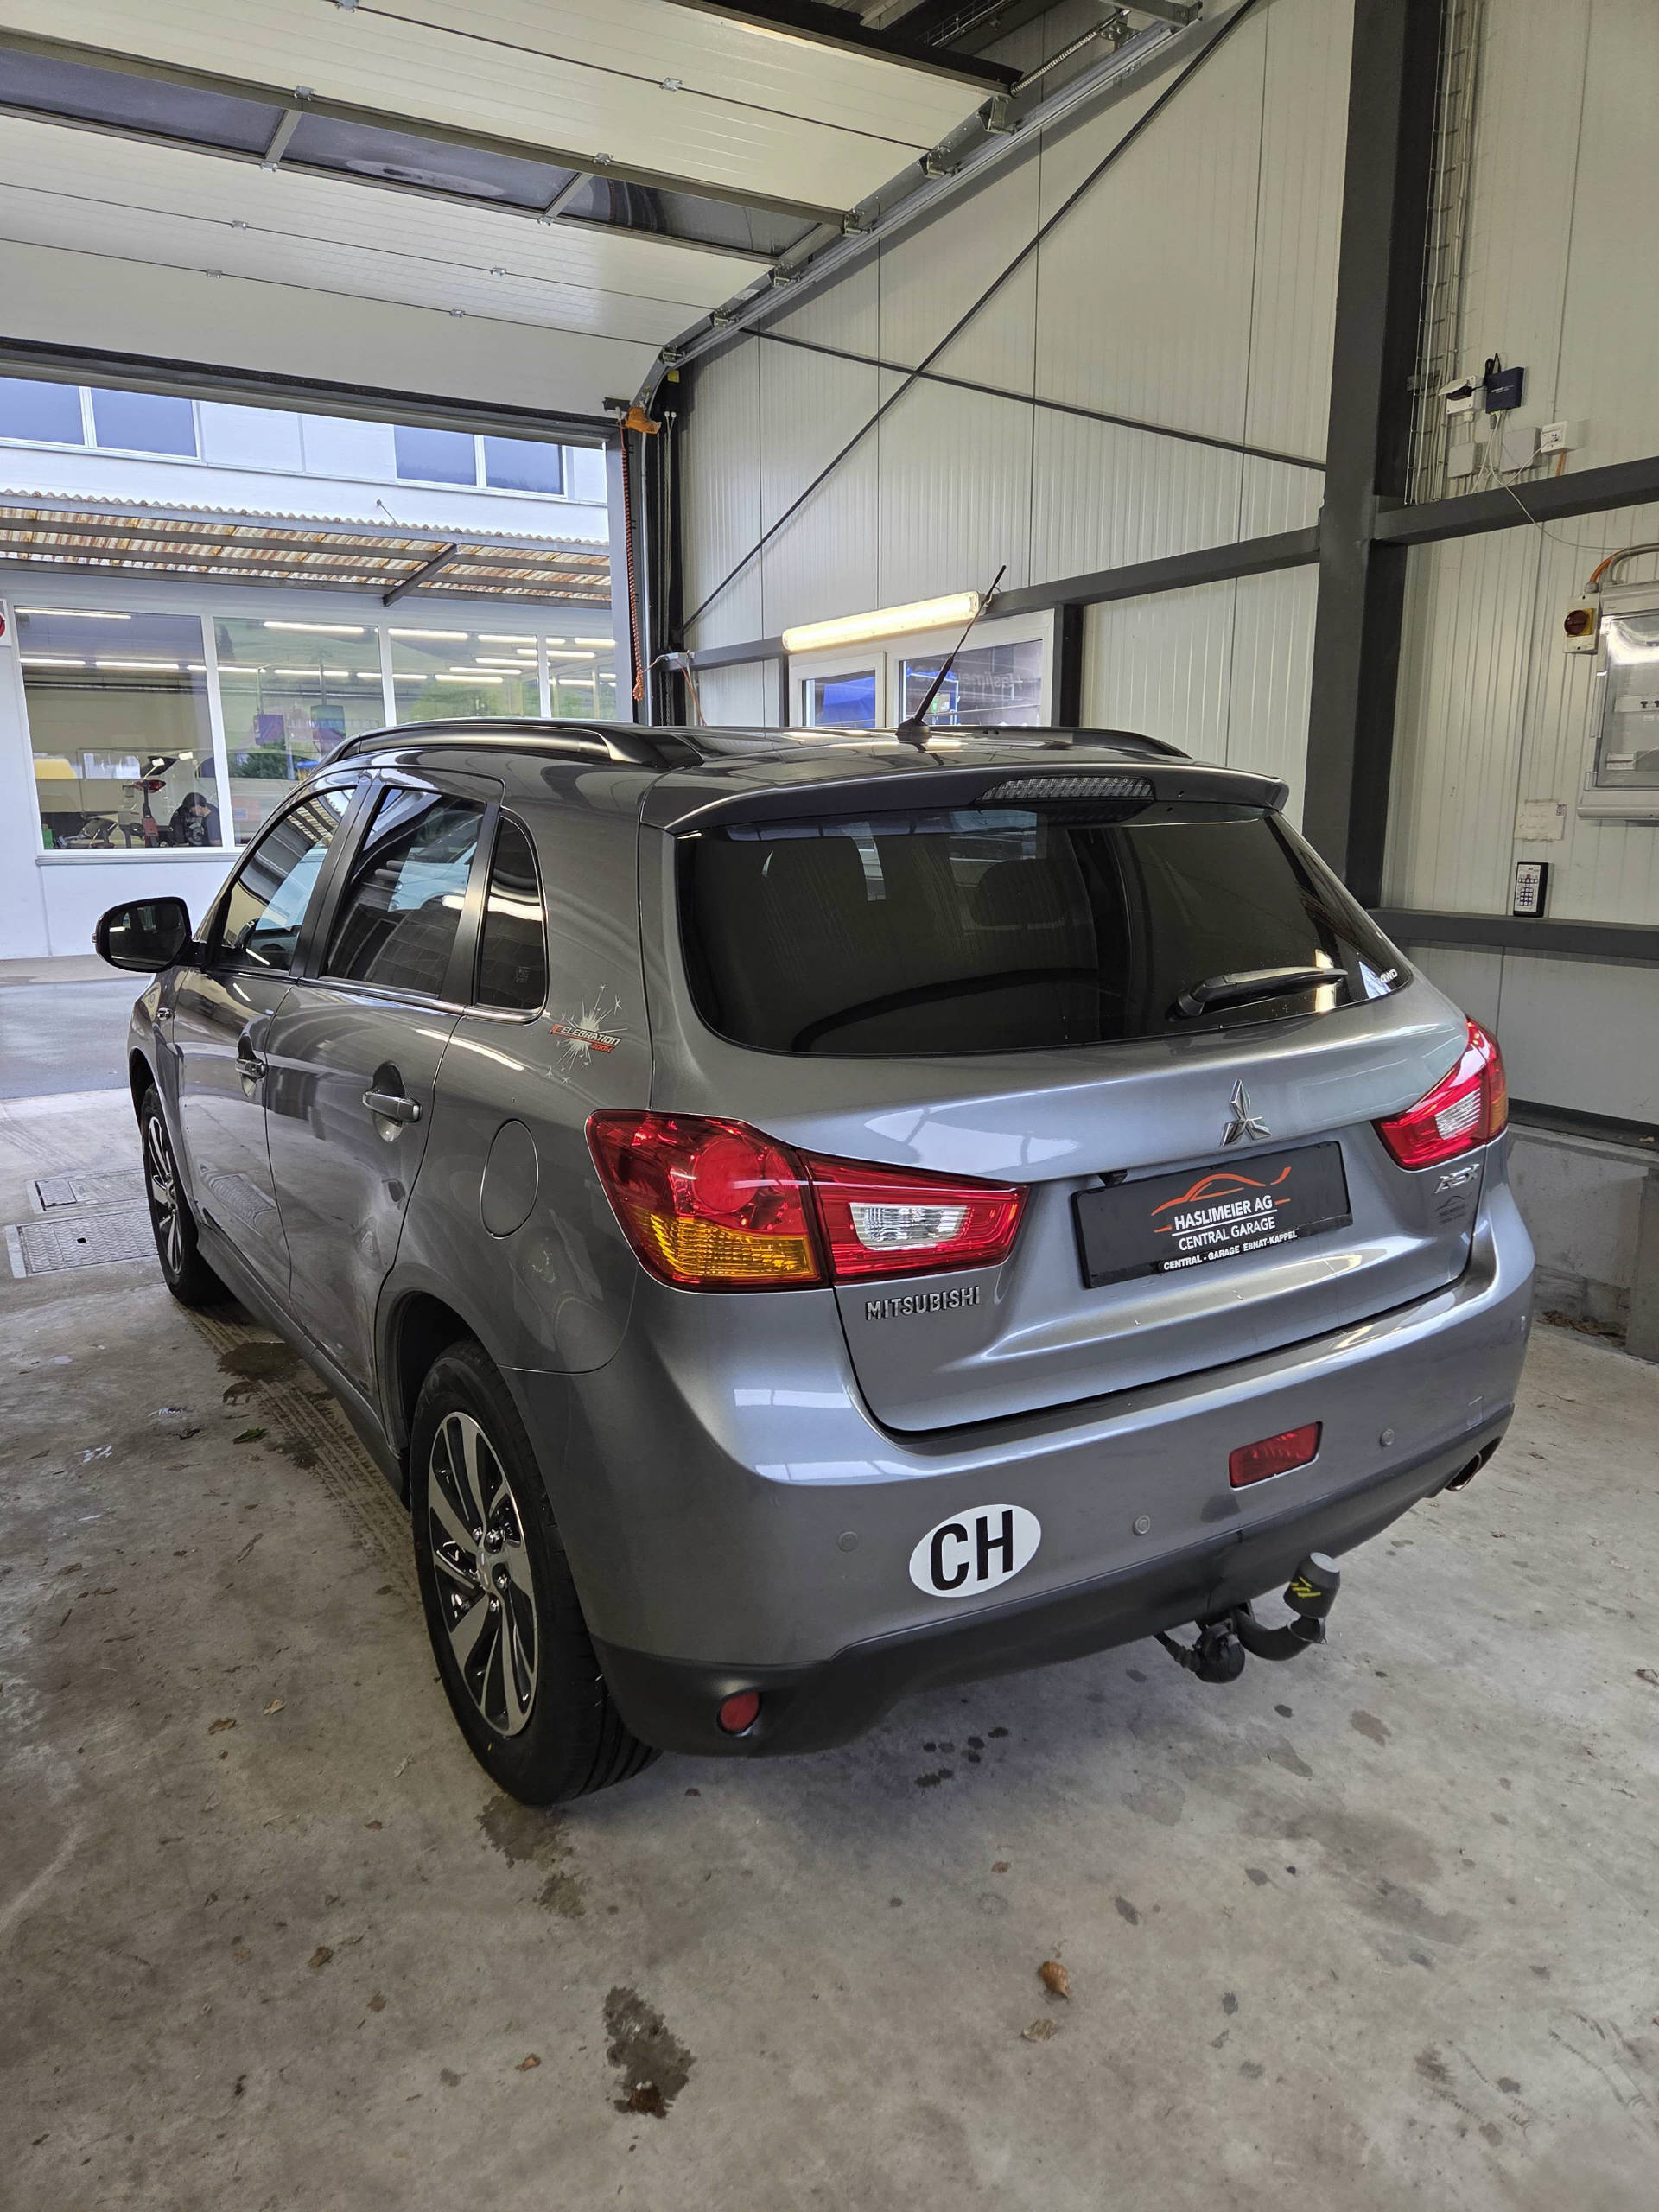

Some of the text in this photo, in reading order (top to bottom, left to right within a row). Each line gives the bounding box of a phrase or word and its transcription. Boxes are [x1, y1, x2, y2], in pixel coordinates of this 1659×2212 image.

[550, 1023, 621, 1046] CELEBRATION
[1174, 1195, 1273, 1230] HASLIMEIER AG
[1164, 1255, 1202, 1271] CENTRAL
[1208, 1245, 1240, 1261] GARAGE
[1243, 1230, 1298, 1252] EBNAT-KAPPEL
[1179, 1217, 1275, 1251] CENTRAL GARAGE
[866, 1286, 981, 1321] MITSUBISHI
[931, 1509, 1014, 1591] CH
